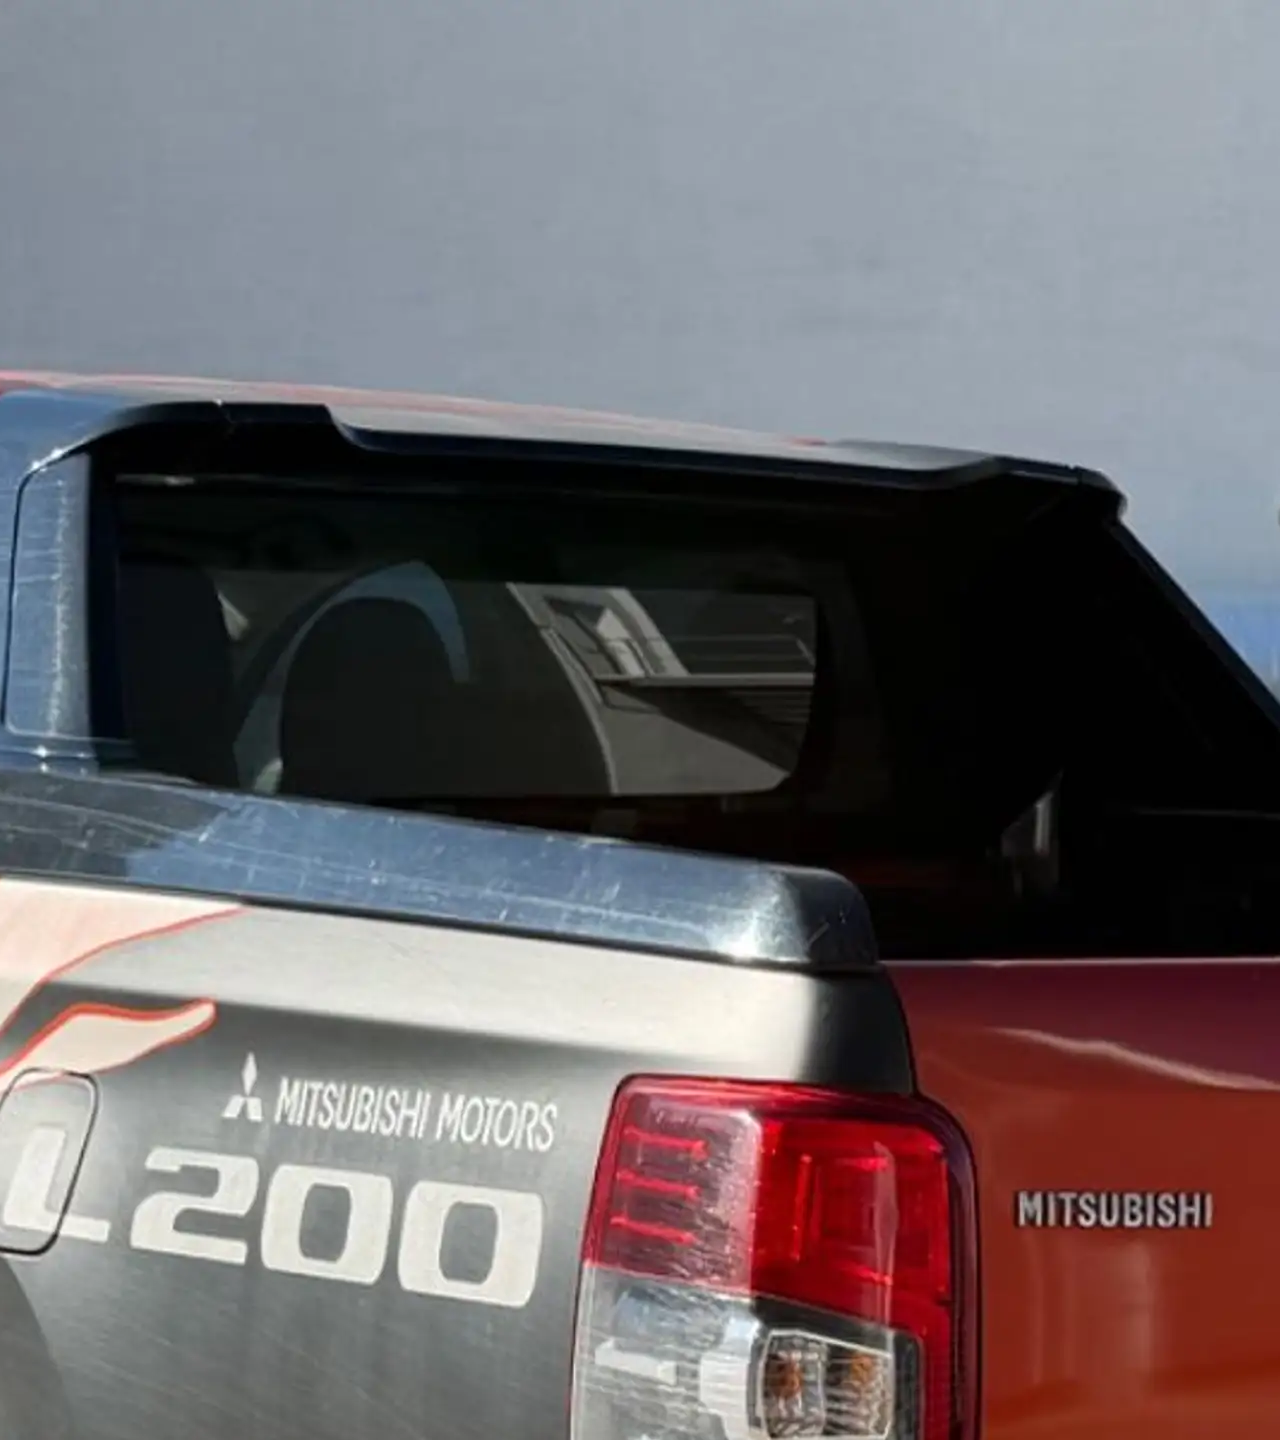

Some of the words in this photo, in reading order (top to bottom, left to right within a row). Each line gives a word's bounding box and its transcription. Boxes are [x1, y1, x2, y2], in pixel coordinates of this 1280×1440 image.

[274, 1075, 431, 1139] MITSUBISHI
[434, 1091, 559, 1153] MOTORS
[1, 1126, 544, 1308] L200
[1016, 1189, 1215, 1229] MITSUBISHI
